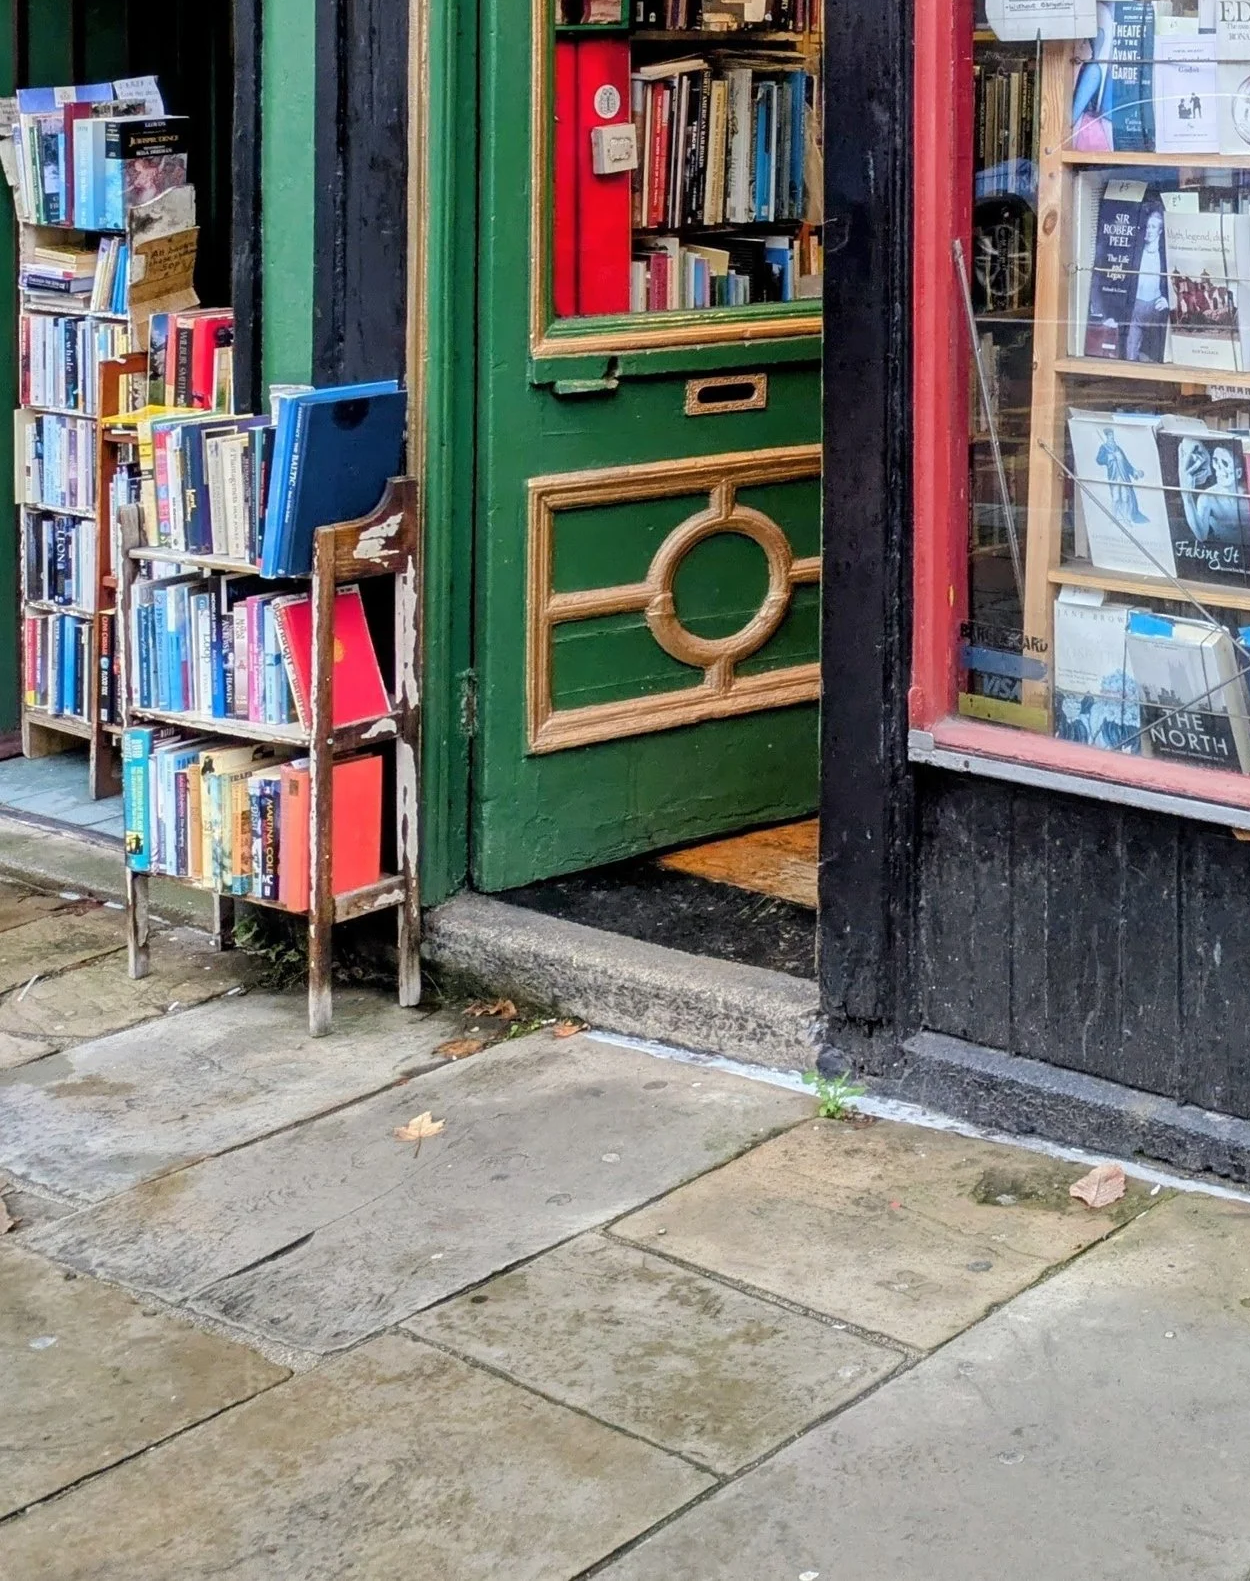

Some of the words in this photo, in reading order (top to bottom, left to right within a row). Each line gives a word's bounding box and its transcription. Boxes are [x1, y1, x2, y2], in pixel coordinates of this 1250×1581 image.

[1111, 65, 1138, 80] GARDE
[1115, 213, 1130, 224] SIR
[1109, 236, 1131, 247] PEEL
[179, 330, 189, 365] WILBUR
[177, 366, 187, 395] SMITH
[288, 454, 300, 488] BALTIC
[1175, 541, 1221, 568] Faking
[1223, 547, 1239, 563] It
[272, 602, 287, 647] OCCUPIED
[281, 646, 294, 667] CITY
[225, 672, 233, 704] HEAVEN
[1162, 709, 1204, 732] THE
[1150, 727, 1228, 756] NORTH
[266, 798, 275, 846] MARTINA
[266, 846, 274, 875] COLE
